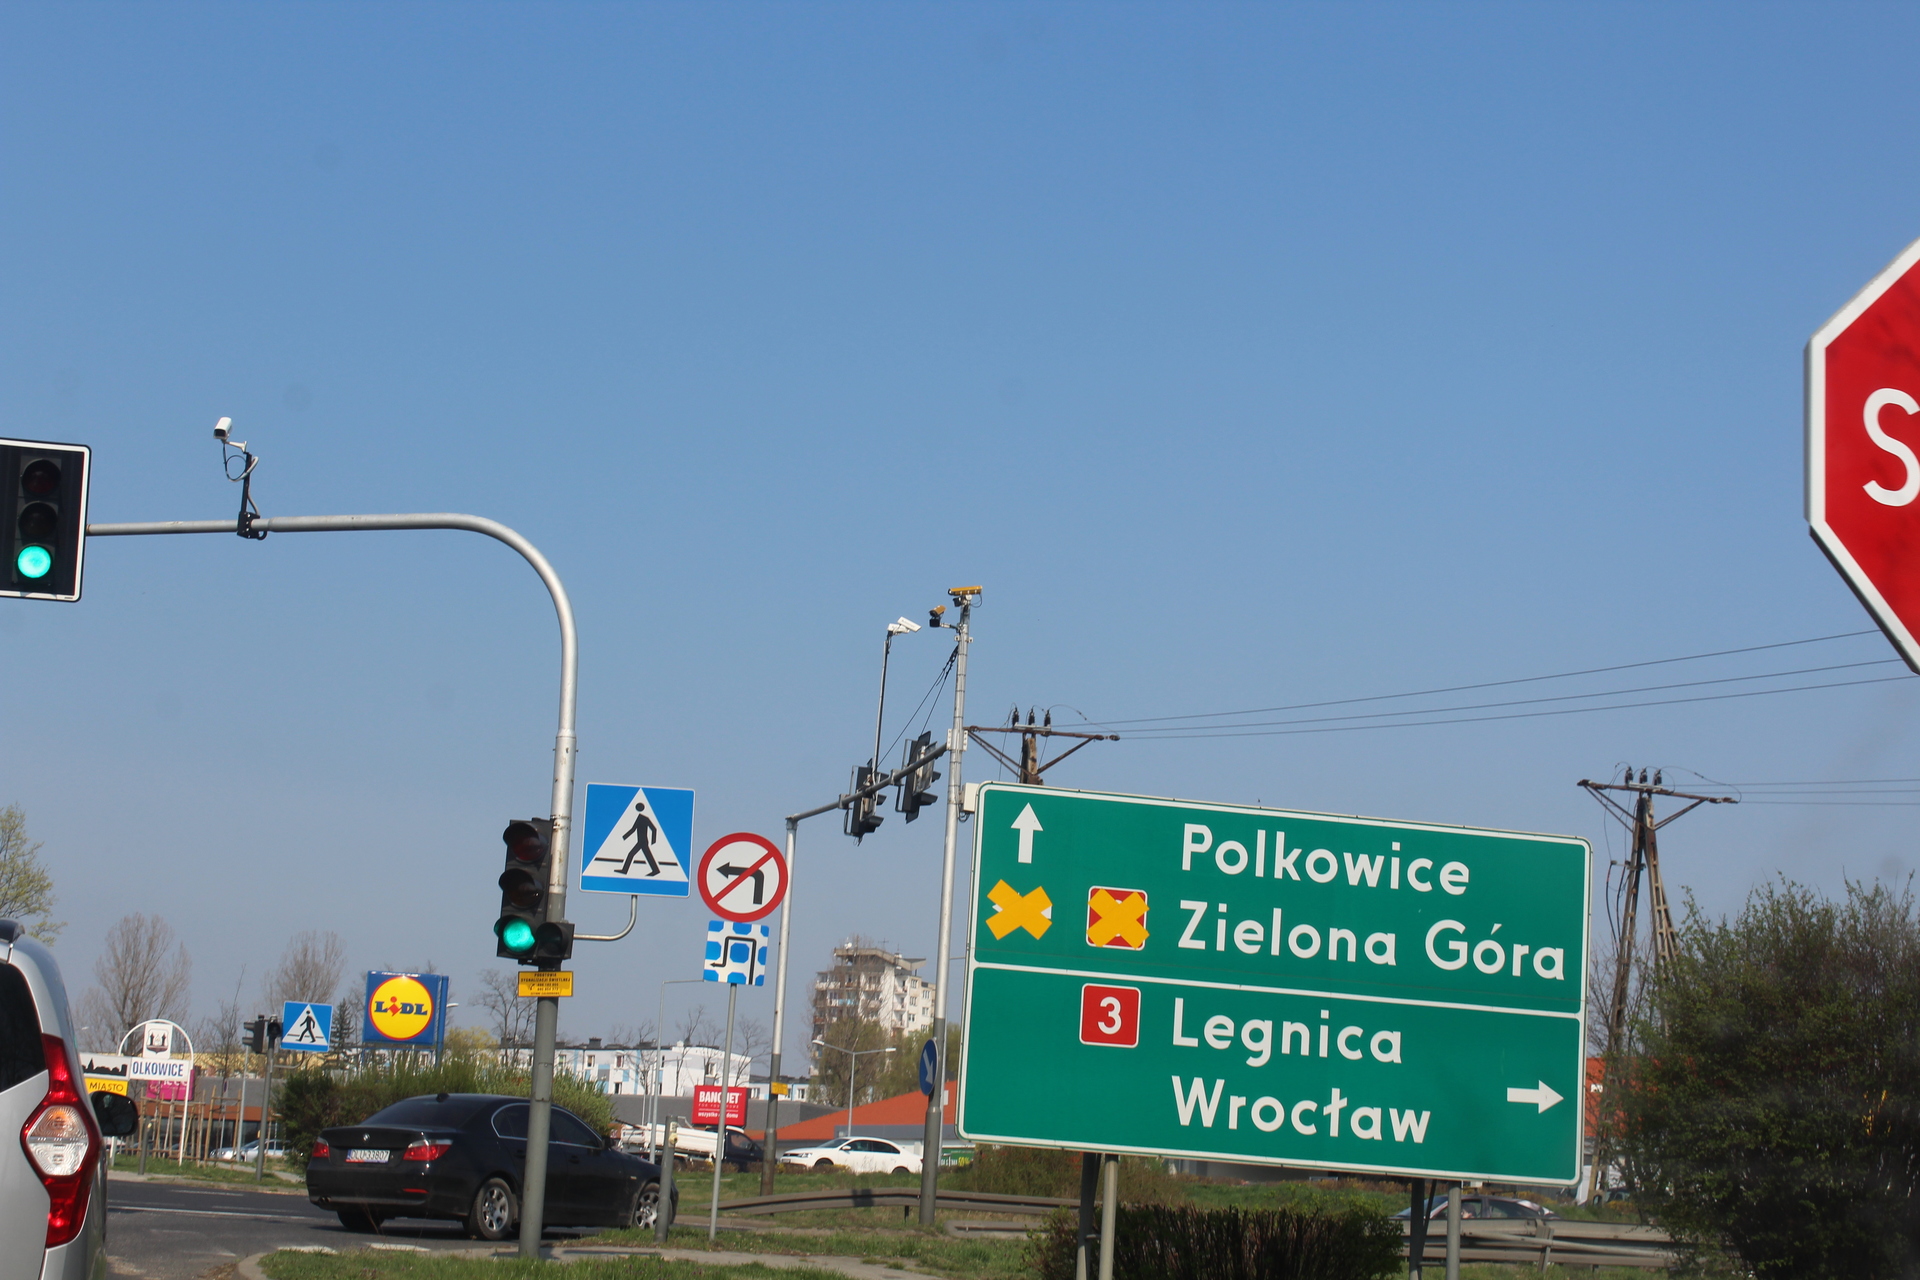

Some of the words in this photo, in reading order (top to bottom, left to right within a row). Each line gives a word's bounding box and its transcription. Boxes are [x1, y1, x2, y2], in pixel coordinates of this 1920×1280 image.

[1182, 823, 1471, 896] Polkowice
[1179, 901, 1397, 967] Zielona
[1425, 920, 1567, 982] Góra
[1098, 997, 1122, 1037] 3
[1173, 998, 1403, 1068] Legnica
[89, 1082, 124, 1092] MIASTO
[132, 1061, 184, 1077] OLKOWICE
[1173, 1076, 1432, 1146] Wrocław
